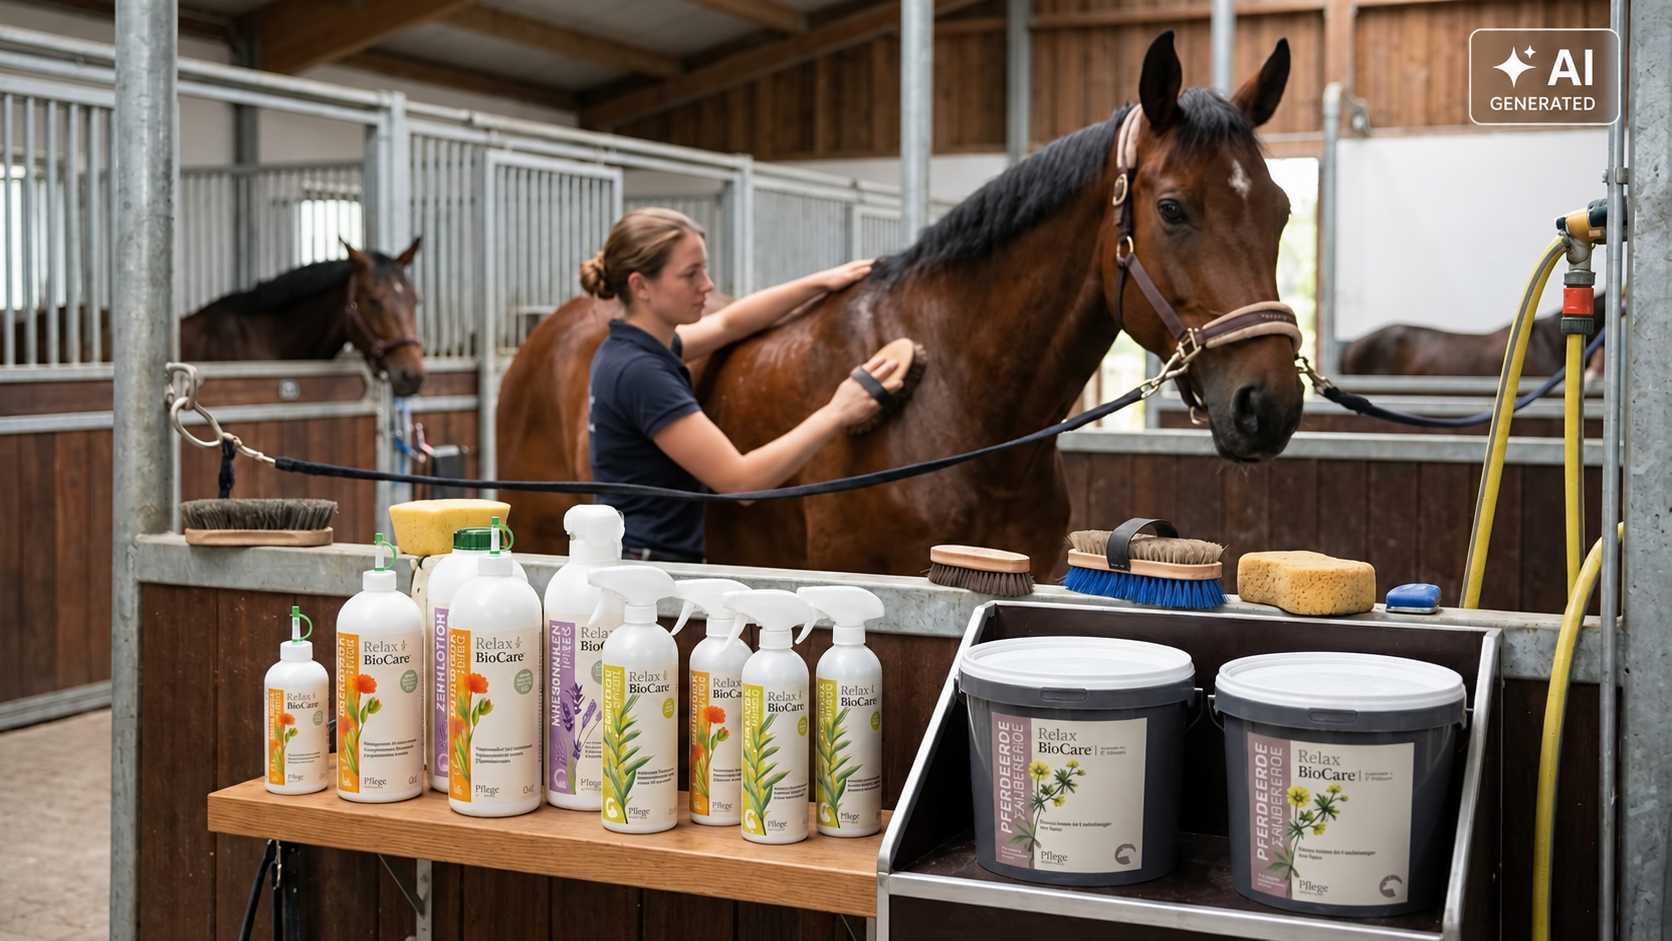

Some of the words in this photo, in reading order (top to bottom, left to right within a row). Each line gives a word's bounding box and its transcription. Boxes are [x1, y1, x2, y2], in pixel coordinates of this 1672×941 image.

[581, 627, 613, 639] Rela
[364, 640, 398, 653] Relax
[476, 637, 513, 650] Relax
[364, 654, 410, 665] BioCare
[476, 652, 525, 663] BioCare
[630, 671, 661, 682] Relax
[629, 684, 670, 694] BioCare
[713, 689, 742, 699] BioCa
[841, 685, 869, 696] Relax
[768, 691, 797, 702] Relax
[841, 697, 878, 707] BioCare
[287, 701, 320, 711] BioCare
[768, 703, 805, 713] BioCare
[1038, 727, 1078, 742] Relax
[1038, 741, 1093, 756] BioCare
[1298, 749, 1341, 766] Relax
[998, 720, 1013, 834] PFERDEERDE
[1298, 765, 1355, 782] BioCare
[475, 784, 500, 797] Pflege
[1255, 742, 1269, 861] PFERDEERDE
[1041, 850, 1069, 864] Pflege
[1299, 880, 1329, 895] Pflege
